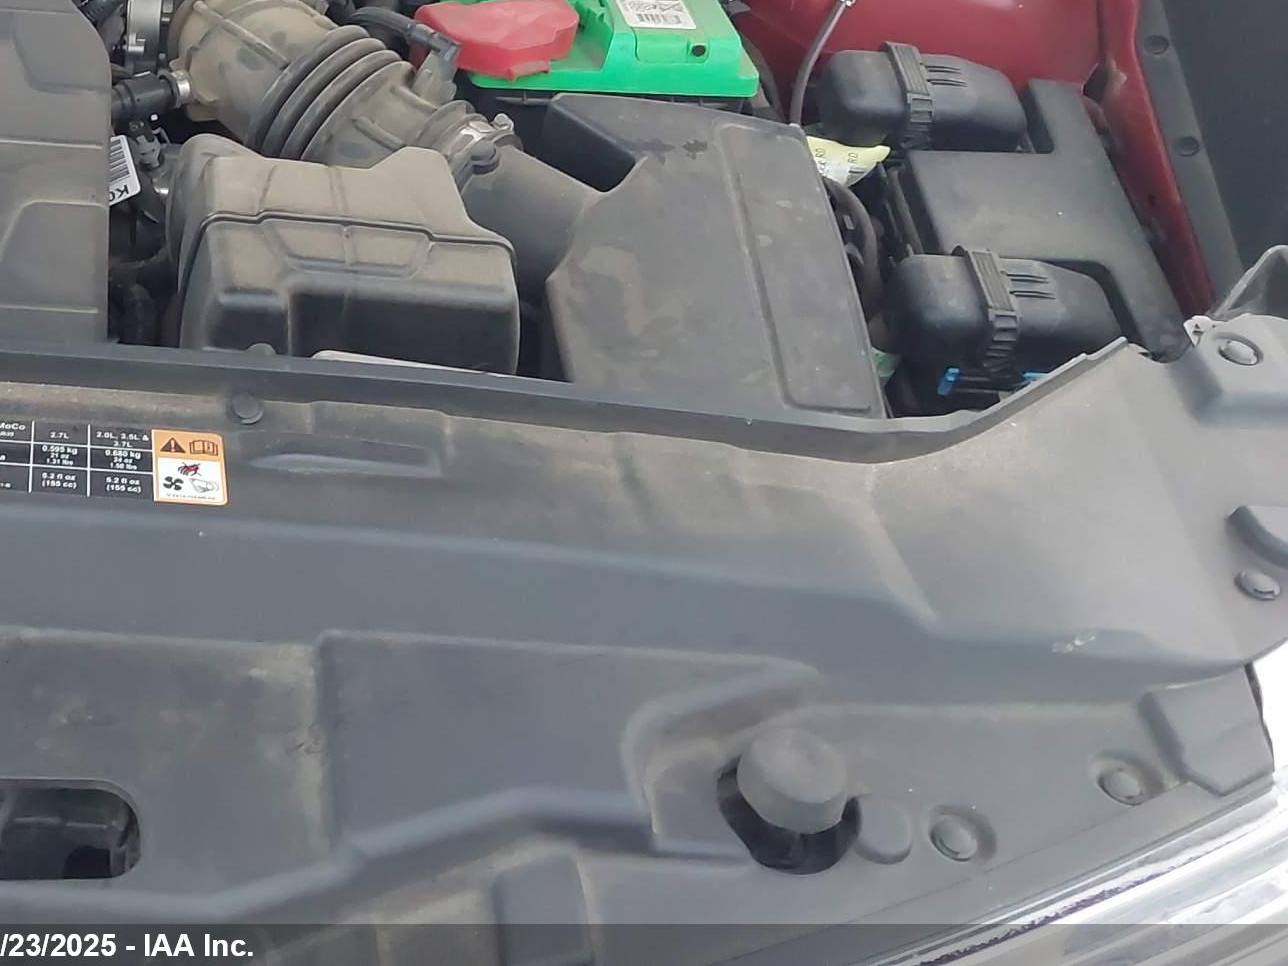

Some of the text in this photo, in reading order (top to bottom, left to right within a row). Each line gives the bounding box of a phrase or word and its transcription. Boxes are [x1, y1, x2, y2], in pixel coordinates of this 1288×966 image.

[49, 431, 69, 439] 2.7L
[66, 446, 78, 455] kg
[129, 451, 141, 460] kg
